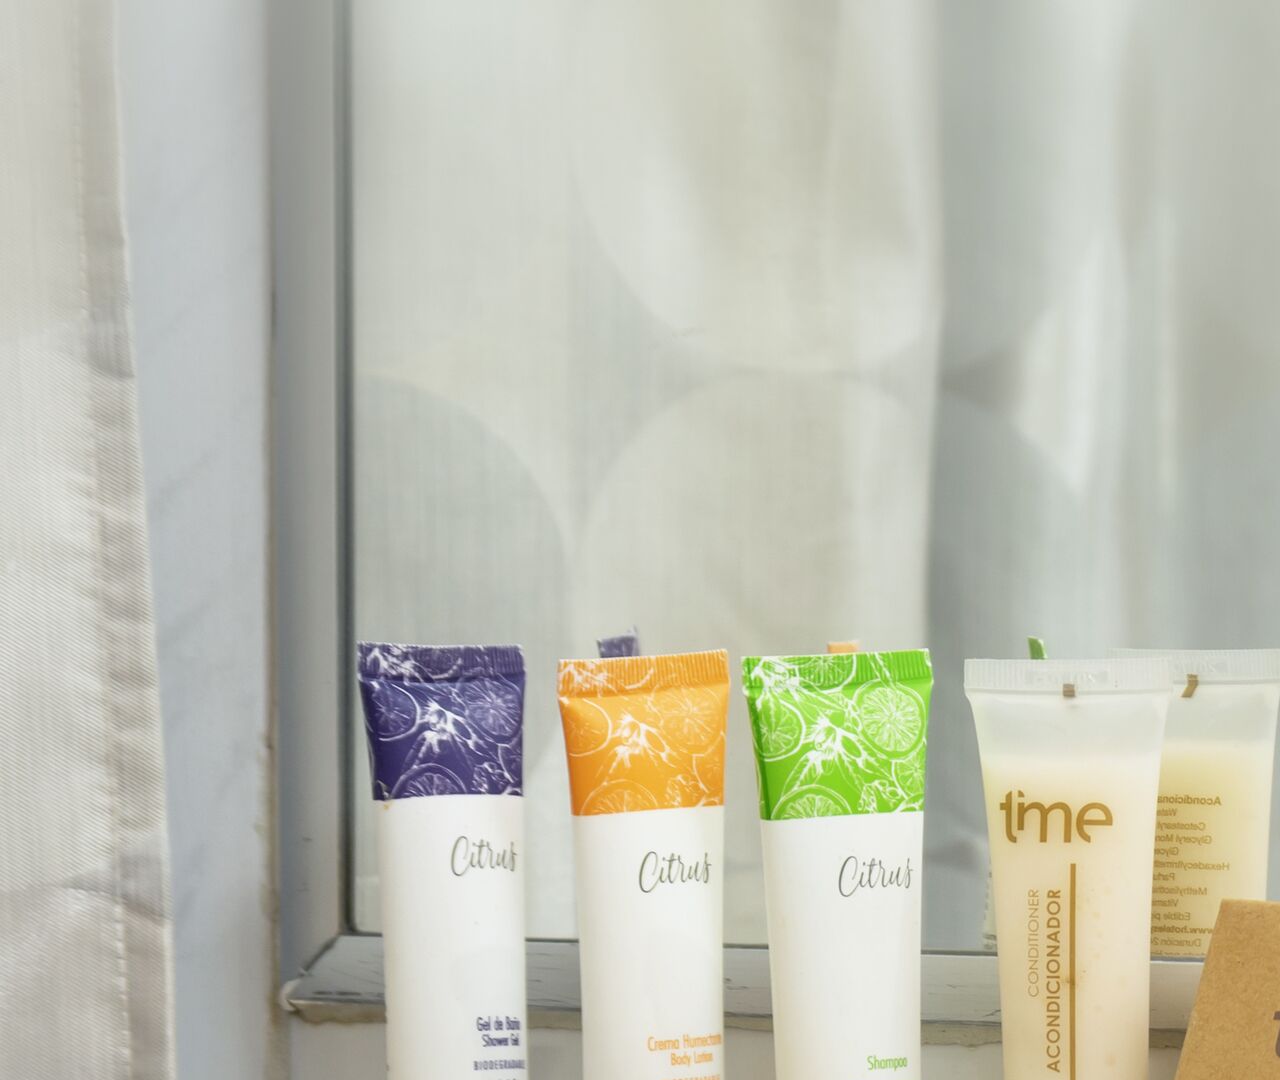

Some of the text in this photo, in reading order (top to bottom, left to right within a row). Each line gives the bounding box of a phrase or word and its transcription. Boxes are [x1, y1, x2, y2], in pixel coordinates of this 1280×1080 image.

[1000, 790, 1113, 843] time
[450, 835, 518, 877] Citrus
[639, 851, 712, 893] Citrus
[838, 856, 914, 897] Citrus
[1028, 888, 1040, 998] CONDITIONER
[1046, 889, 1061, 1073] ACONDICIONADOR
[476, 1016, 491, 1031] Gel
[494, 1016, 503, 1031] de
[647, 1036, 680, 1052] Crema
[671, 1052, 691, 1067] Body
[866, 1055, 908, 1072] Shampoo
